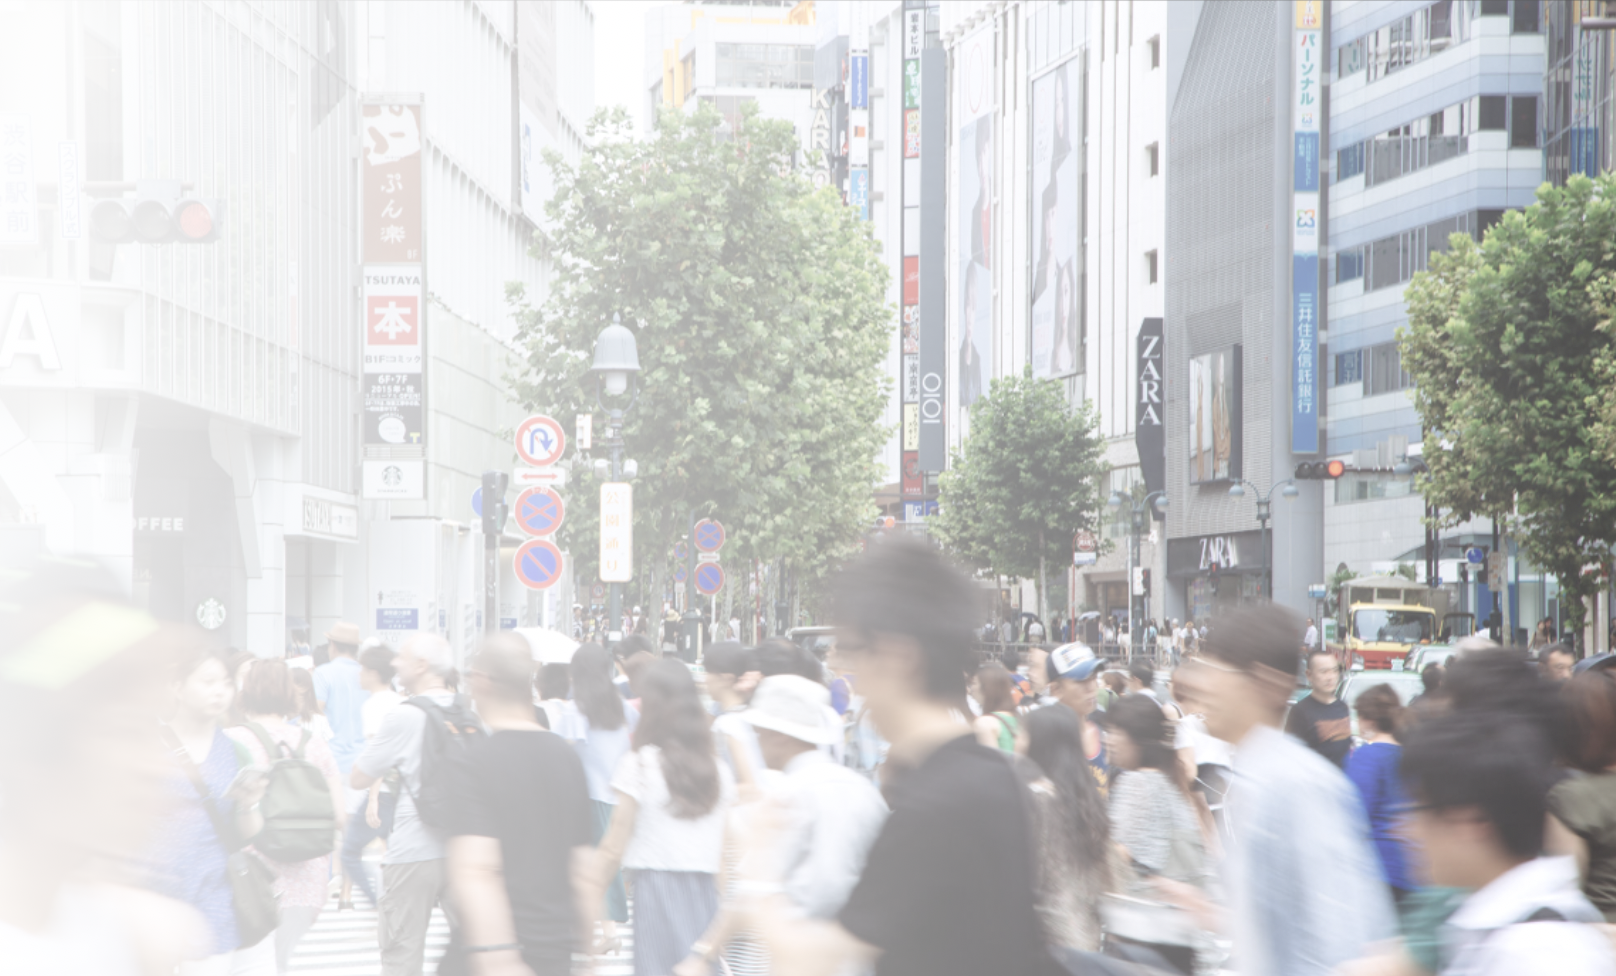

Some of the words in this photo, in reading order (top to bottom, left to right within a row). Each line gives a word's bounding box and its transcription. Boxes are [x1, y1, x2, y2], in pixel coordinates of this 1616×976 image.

[1301, 34, 1315, 105] パーソナル
[4, 123, 29, 233] 渋谷駅前
[64, 147, 77, 234] スクランブル式
[381, 173, 405, 244] ぷん楽
[365, 275, 421, 285] TSUTAYA
[374, 301, 412, 340] 本
[1298, 292, 1312, 414] 三井住友信託銀行
[1140, 335, 1162, 425] ZARA
[1200, 536, 1239, 570] ZARA
